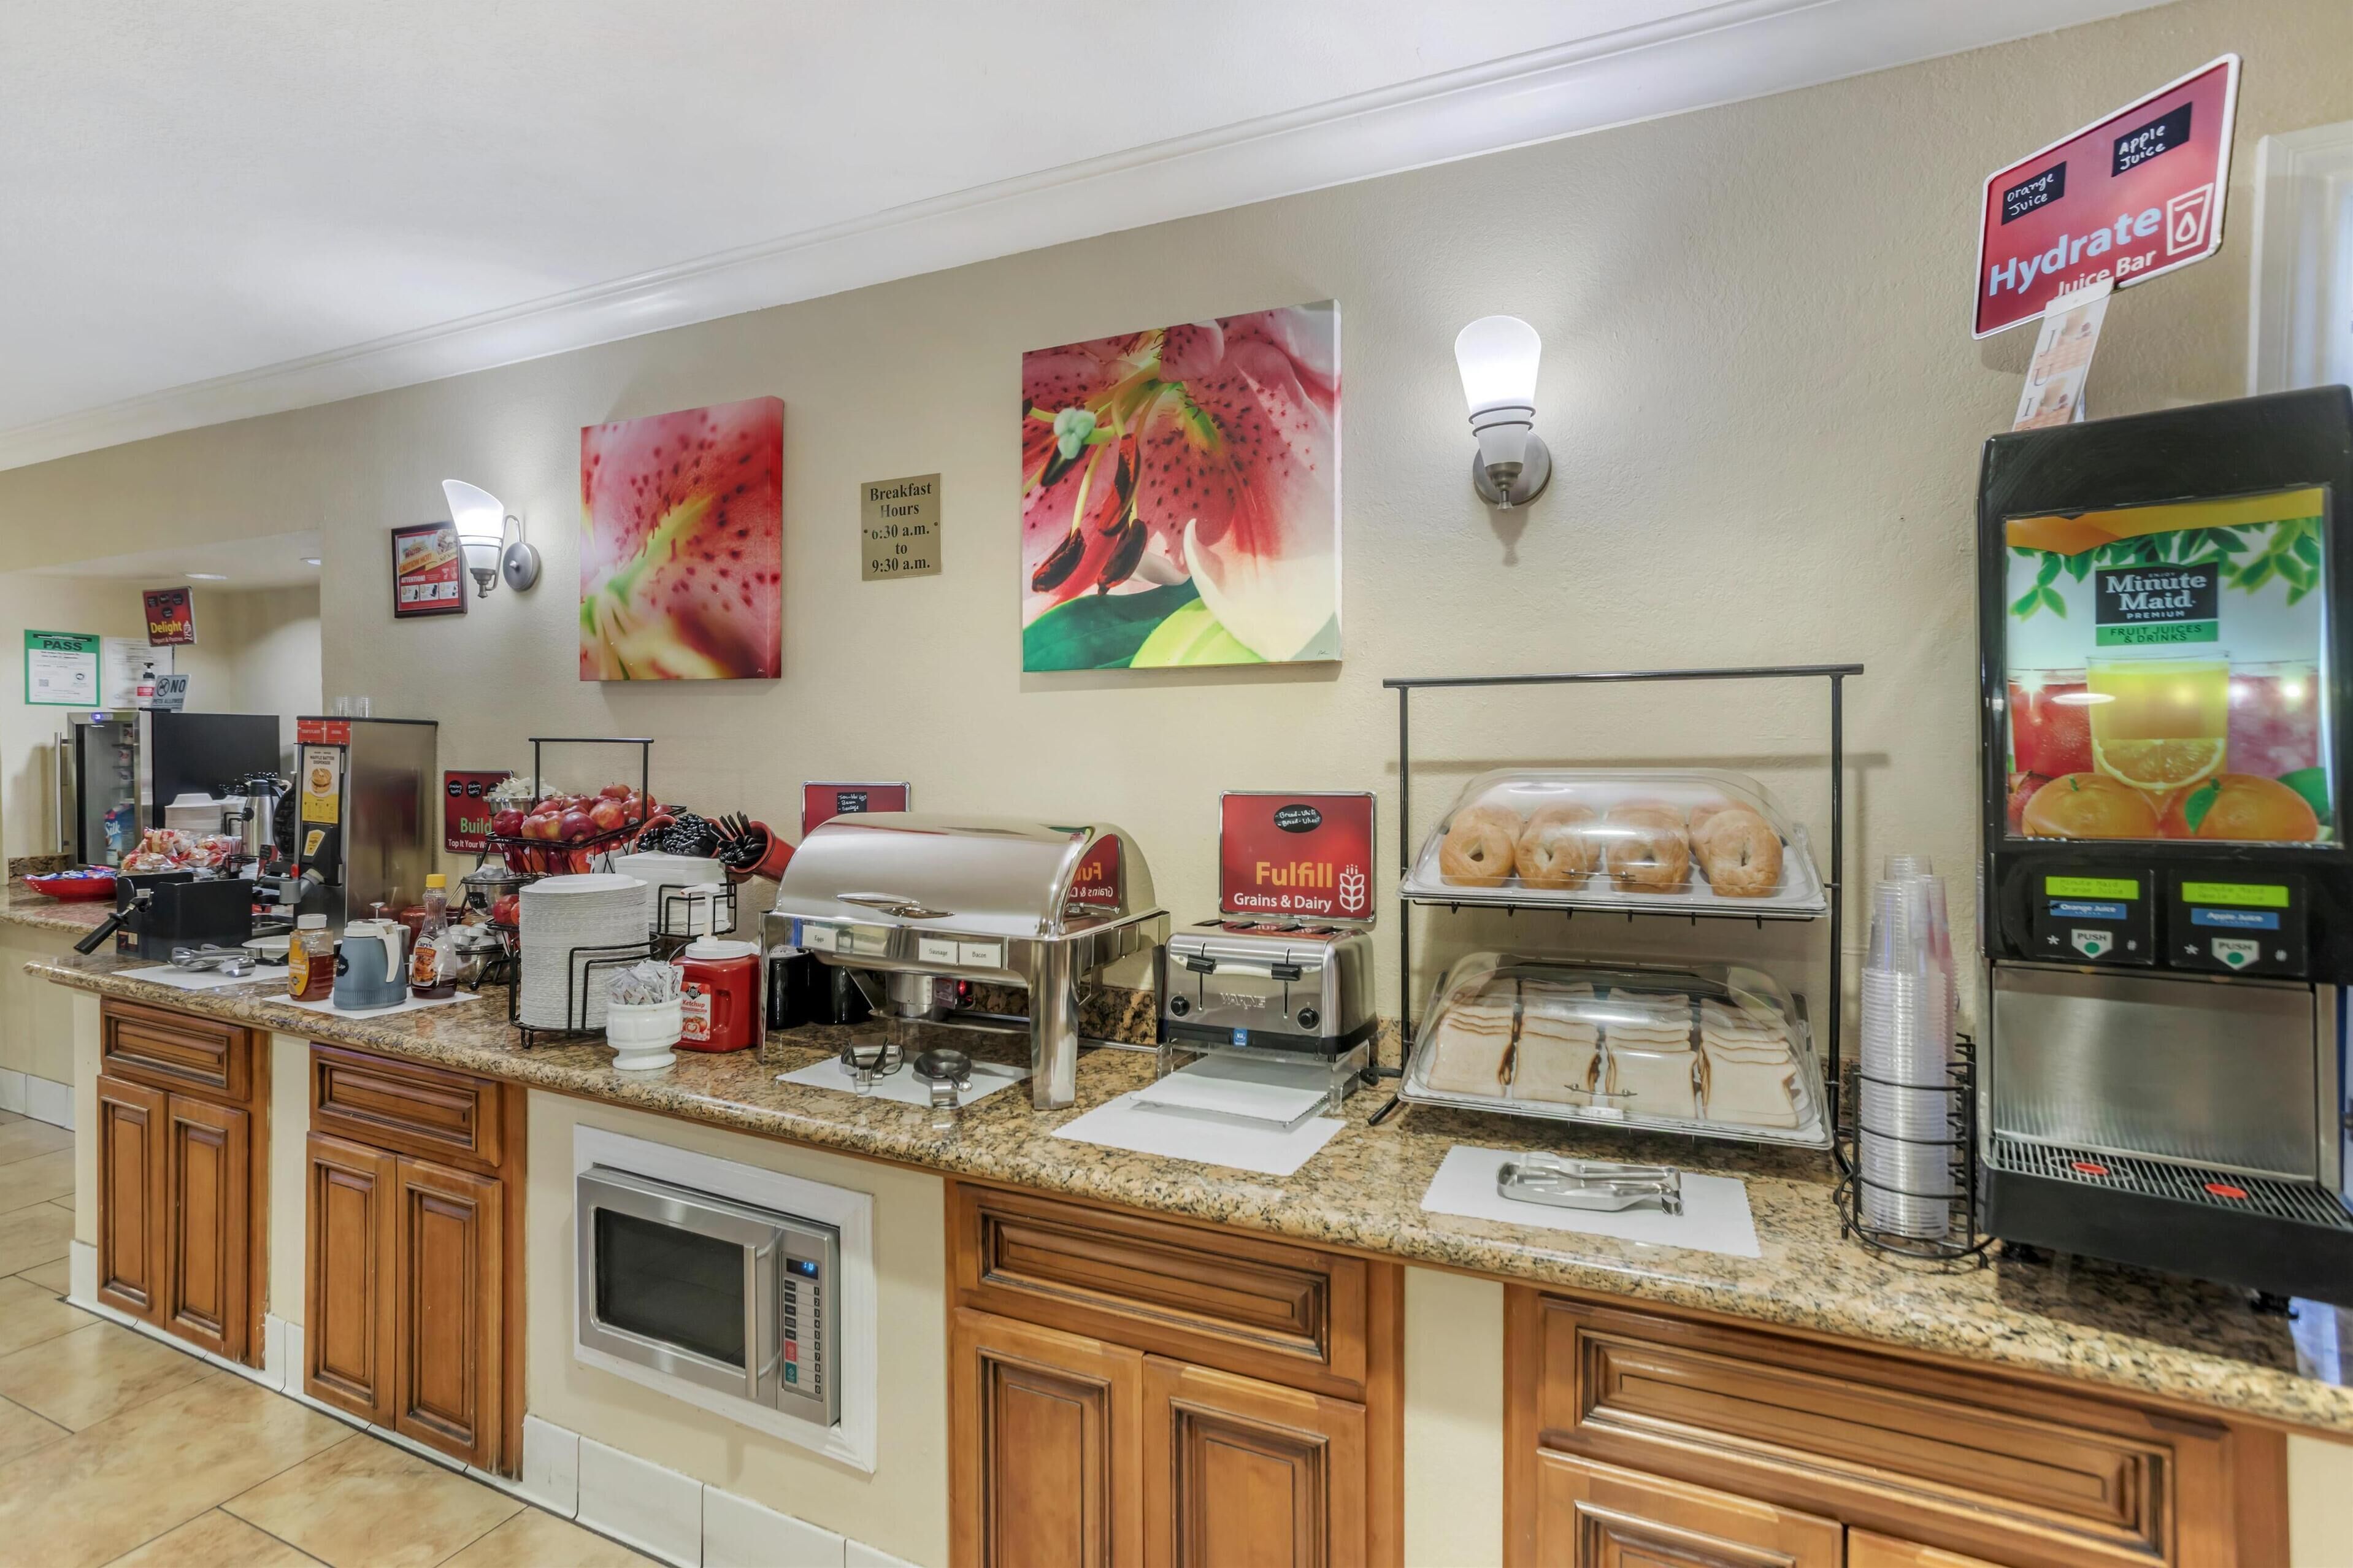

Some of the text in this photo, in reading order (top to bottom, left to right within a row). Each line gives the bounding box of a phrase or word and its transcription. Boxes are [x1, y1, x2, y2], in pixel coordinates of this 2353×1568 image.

[2120, 143, 2166, 170] Juice
[2008, 193, 2048, 216] Juice
[1989, 208, 2162, 296] Hydrate
[2116, 250, 2156, 277] Bar
[870, 482, 932, 501] Breakfast
[880, 504, 919, 518] Hours
[872, 524, 930, 539] 6:30 a.m.
[896, 542, 908, 555] to
[872, 557, 931, 573] 9:30 a.m.
[2106, 573, 2207, 593] Minute
[2119, 590, 2193, 610] Maid
[2127, 610, 2185, 620] PREMIUM
[150, 621, 182, 635] Delight
[2110, 624, 2202, 636] FRUIT JUICES
[2137, 633, 2187, 643] DRINKS
[44, 640, 83, 651] PASS
[171, 679, 186, 693] NO
[106, 820, 122, 836] Silk
[460, 817, 492, 834] Build
[448, 839, 459, 848] Top
[464, 840, 478, 848] Your
[1256, 861, 1332, 888] Fulfill
[1234, 893, 1332, 913] Grains & Dairy
[2060, 904, 2092, 913] Orange
[2077, 932, 2107, 941] PUSH
[929, 948, 948, 957] Sausage
[2219, 942, 2253, 951] PUSH
[682, 999, 705, 1009] Ketchup
